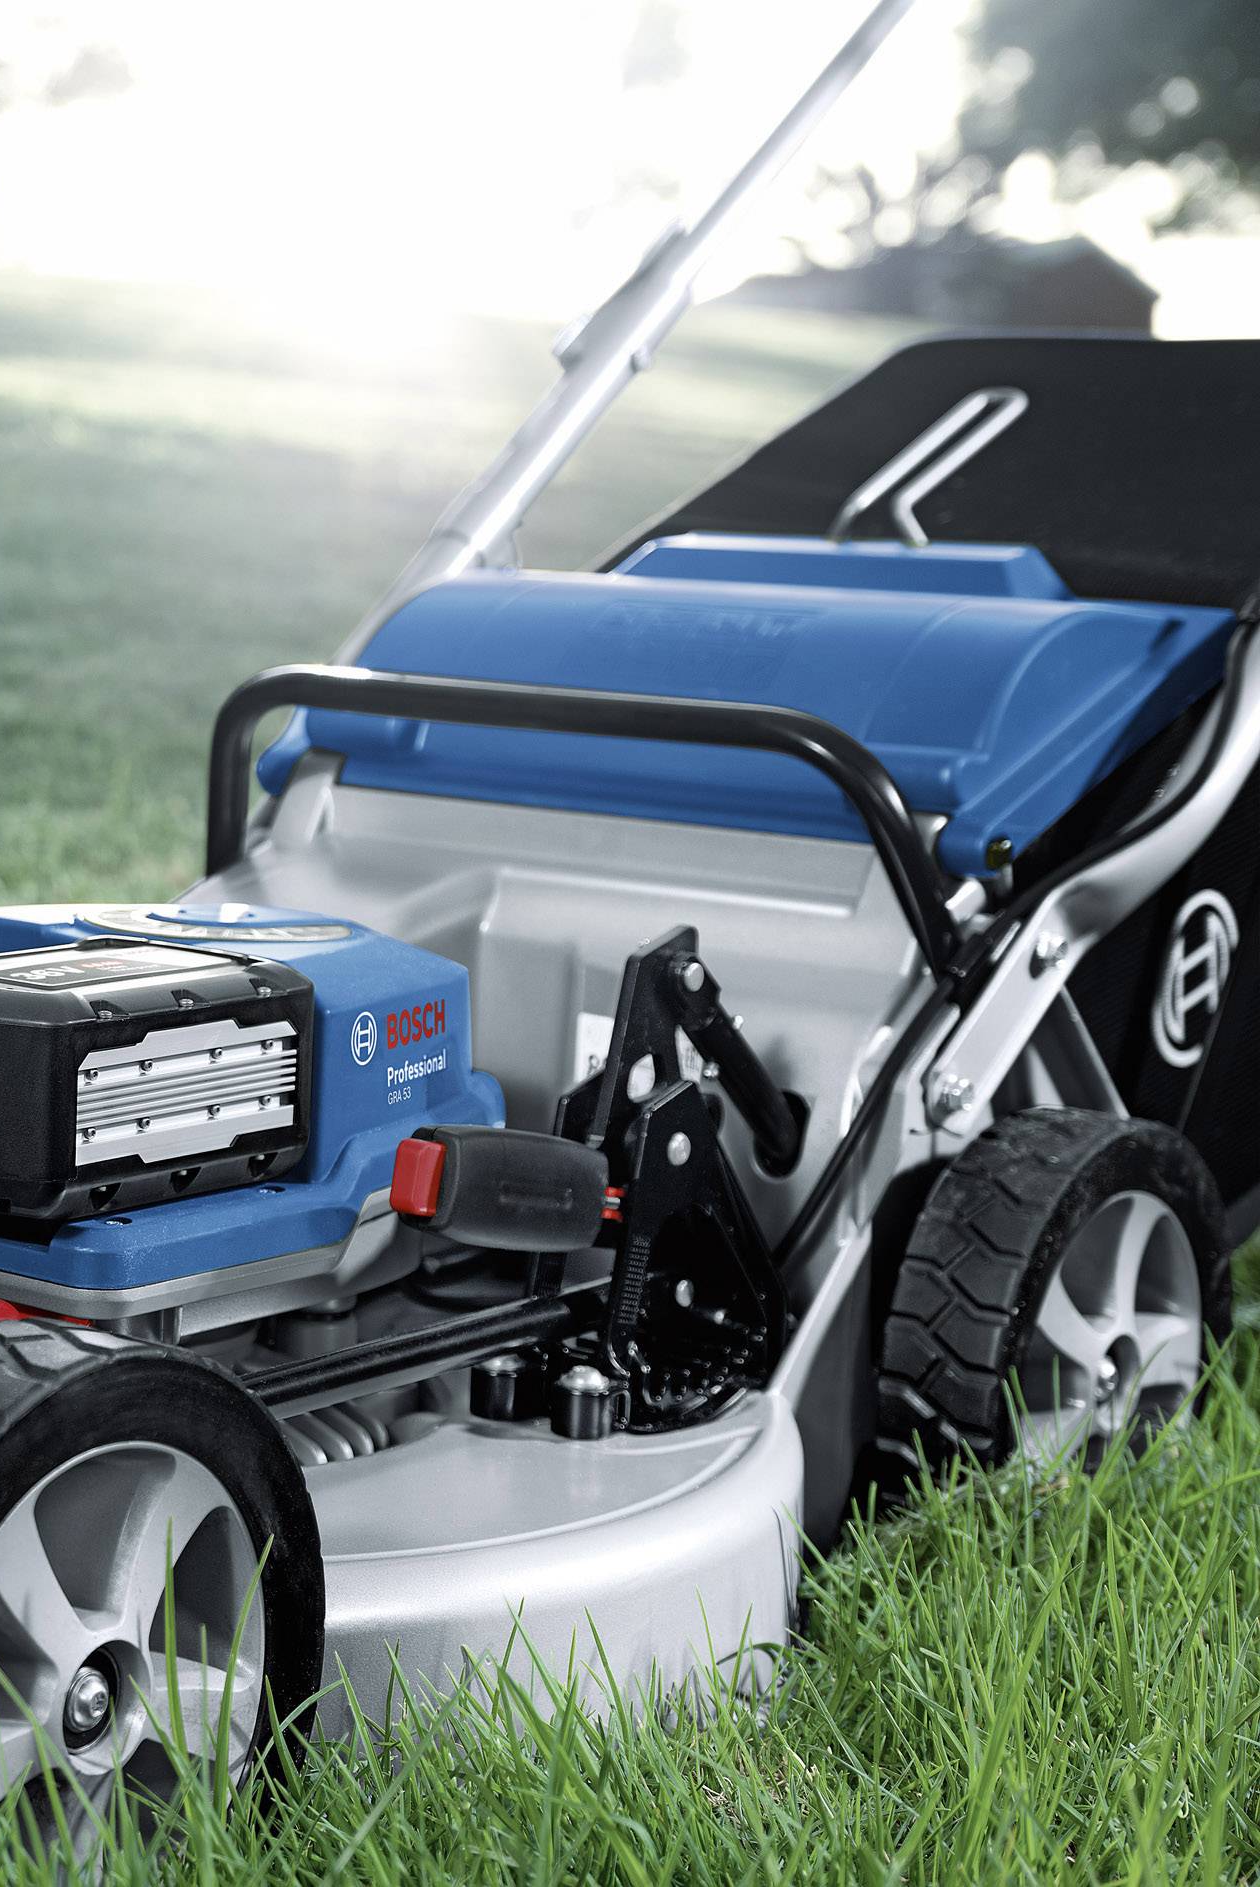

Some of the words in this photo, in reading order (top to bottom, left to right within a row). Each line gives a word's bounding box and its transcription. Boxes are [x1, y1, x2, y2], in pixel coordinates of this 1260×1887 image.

[387, 999, 445, 1050] BOSCH
[387, 1048, 446, 1087] Professional
[387, 1089, 402, 1105] GRA
[403, 1086, 412, 1101] 53
